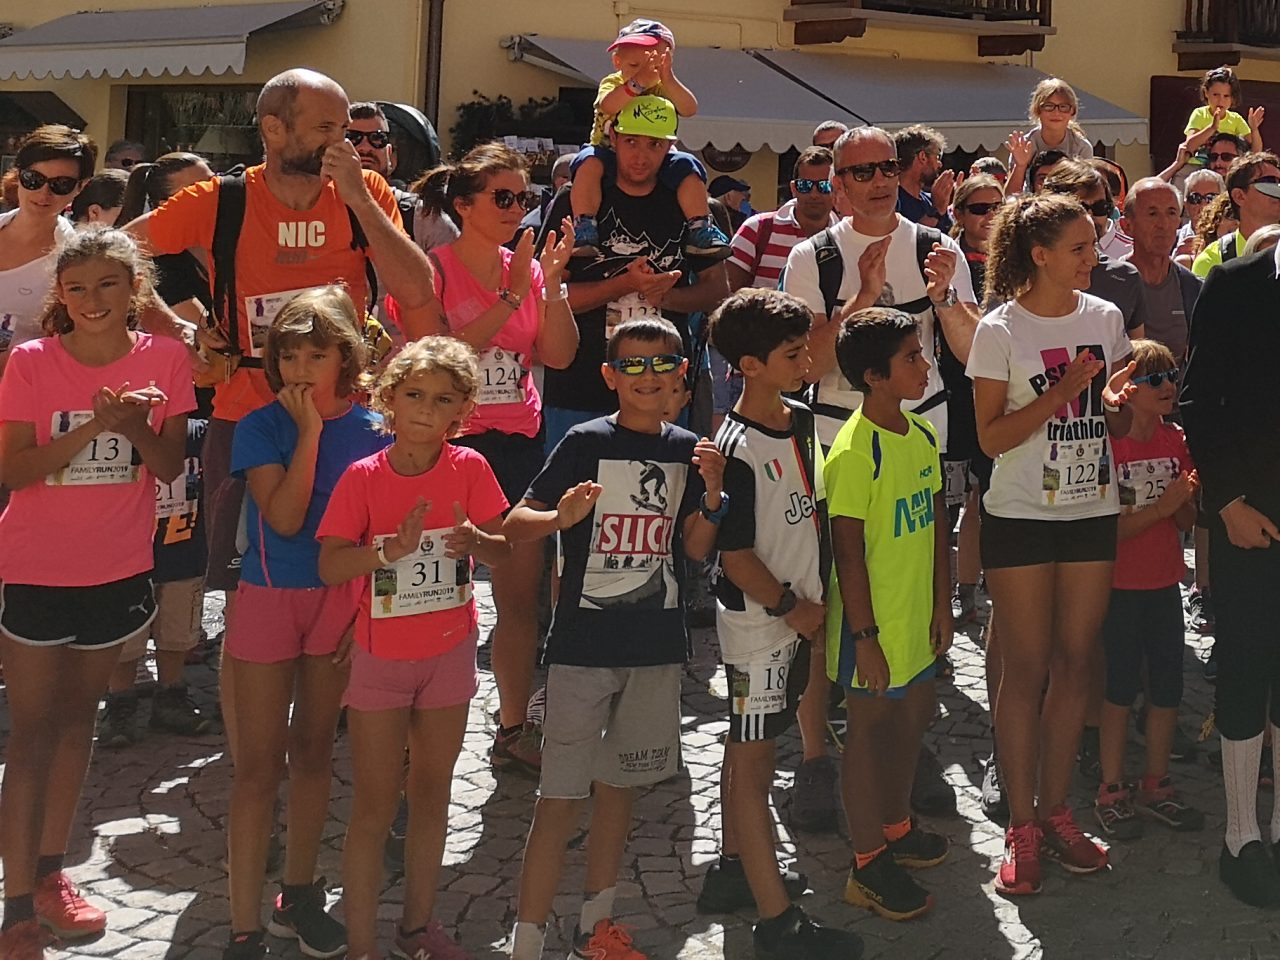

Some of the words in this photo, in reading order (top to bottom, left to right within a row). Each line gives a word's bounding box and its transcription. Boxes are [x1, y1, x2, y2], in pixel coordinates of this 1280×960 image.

[278, 220, 326, 248] NIC
[484, 367, 519, 386] 124
[87, 437, 120, 462] 13
[1066, 463, 1096, 486] 122
[1145, 479, 1166, 500] 25
[411, 559, 443, 587] 31
[398, 586, 455, 601] FAMILYRUN2019
[764, 665, 786, 691] 18
